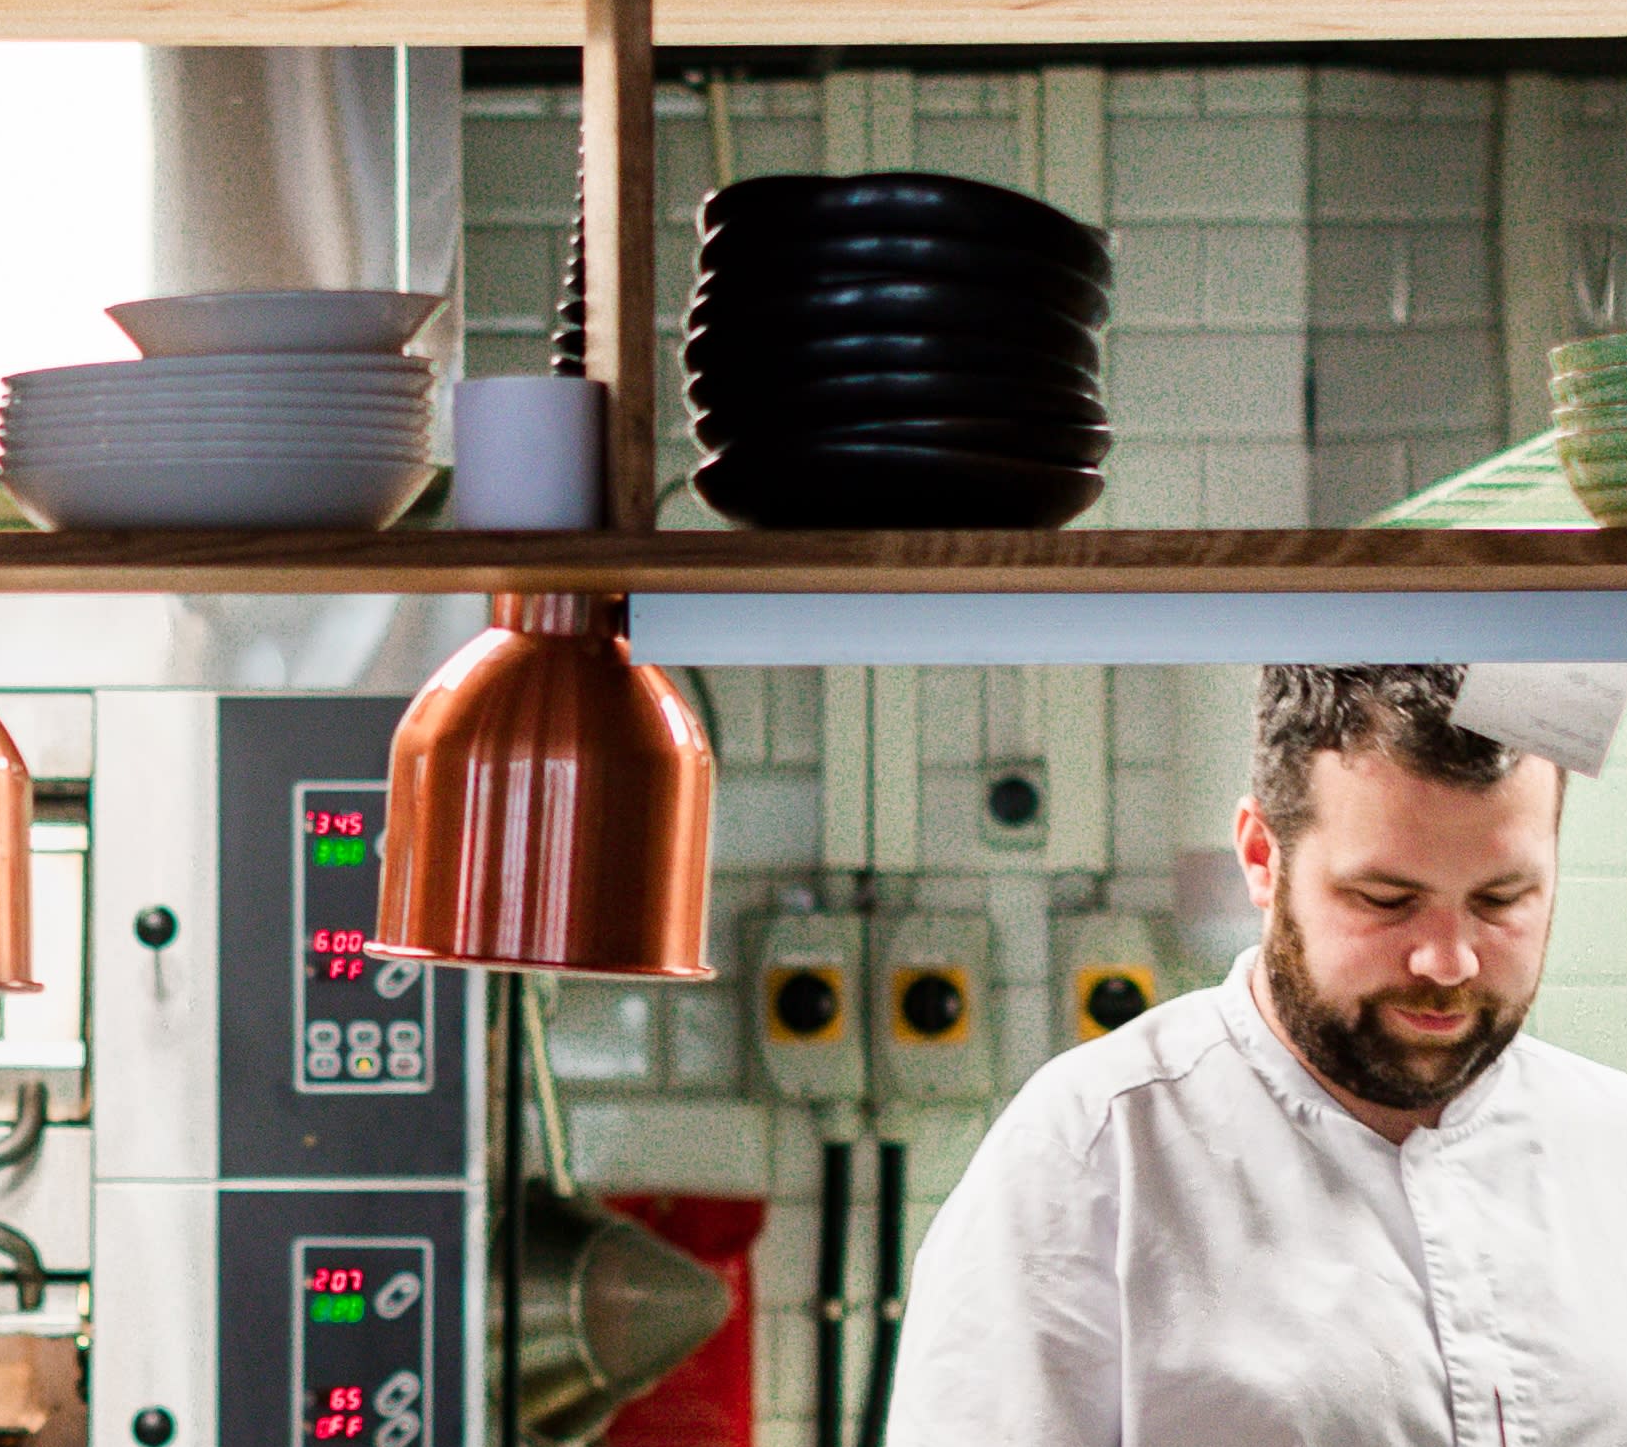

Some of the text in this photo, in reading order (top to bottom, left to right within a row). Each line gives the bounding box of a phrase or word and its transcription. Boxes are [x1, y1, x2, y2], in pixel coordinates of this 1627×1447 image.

[315, 811, 364, 835] 345
[311, 1267, 364, 1293] 207
[329, 1387, 363, 1411] 65
